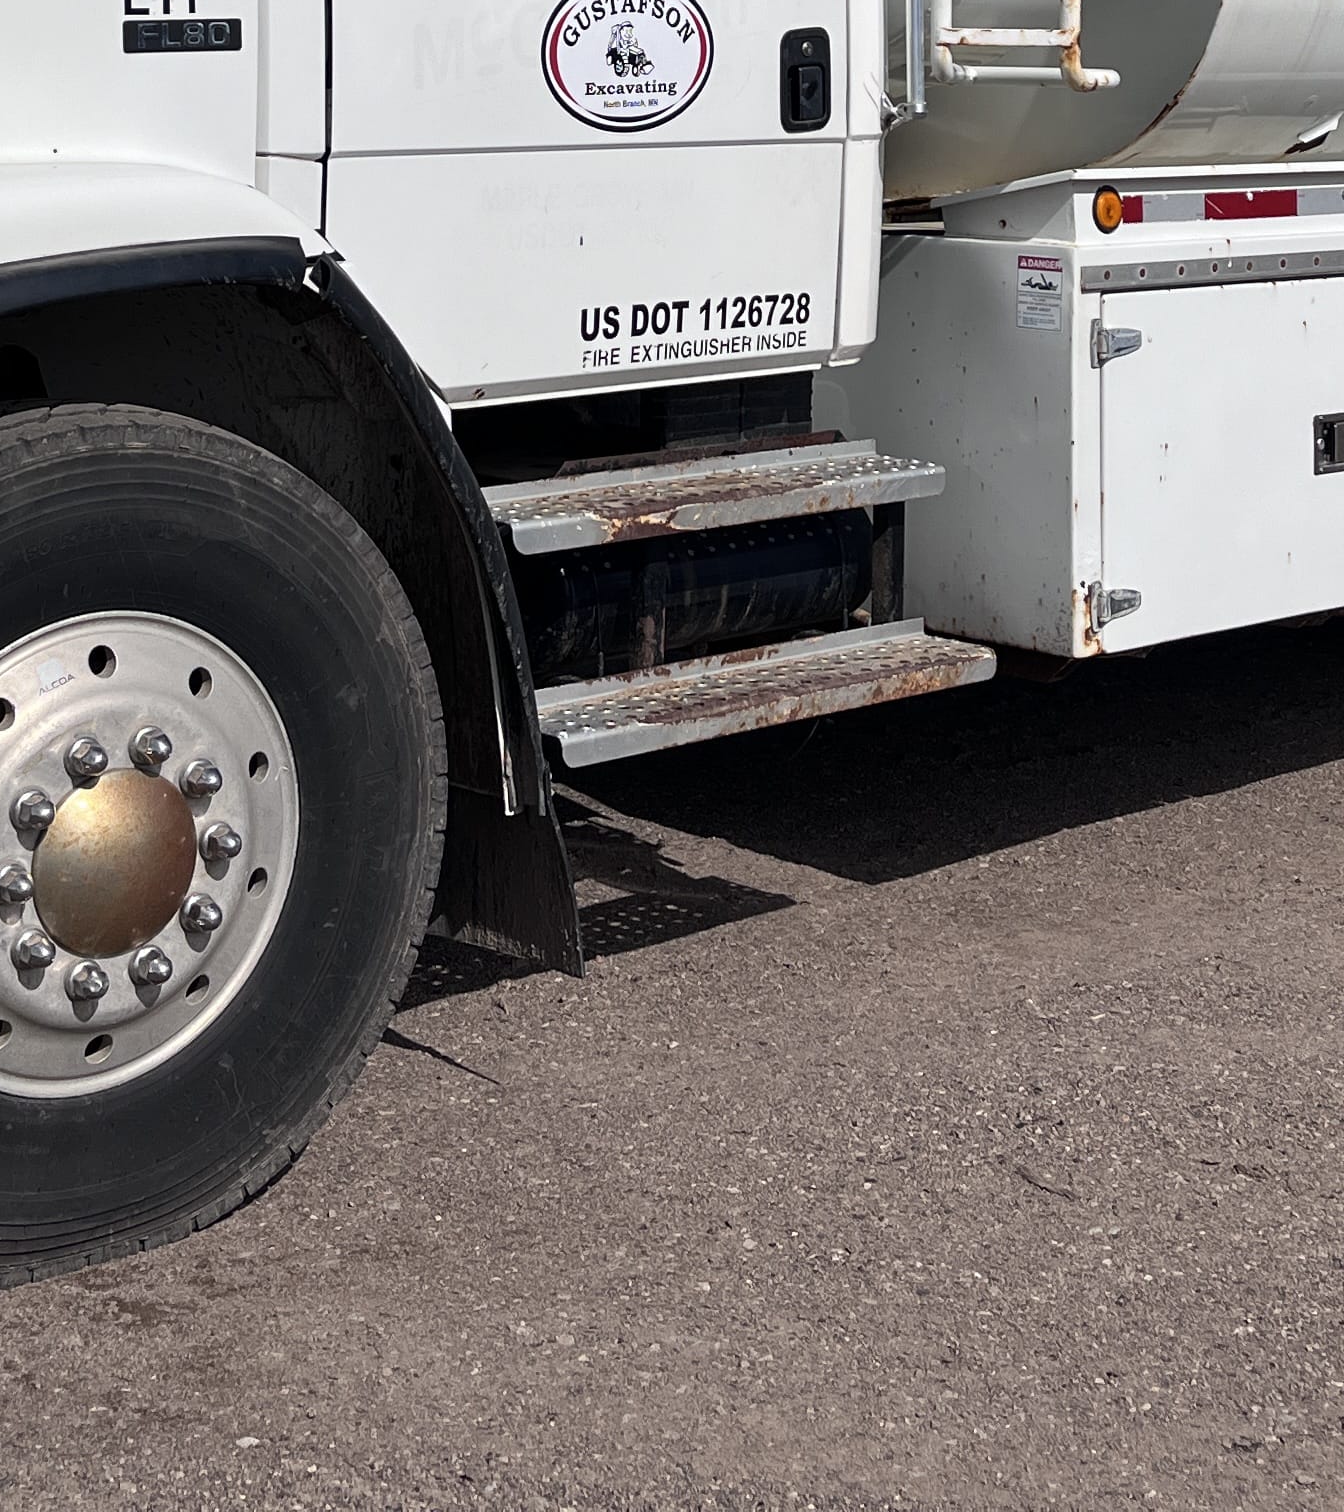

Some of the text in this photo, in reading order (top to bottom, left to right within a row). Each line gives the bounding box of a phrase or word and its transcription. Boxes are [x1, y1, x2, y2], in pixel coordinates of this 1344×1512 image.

[137, 21, 231, 48] FL80
[584, 79, 678, 96] Excavating
[580, 293, 810, 341] US DOT 1126728
[582, 331, 808, 368] FIRE EXTINGUISHER INSIDE
[39, 674, 75, 696] ALCOA
